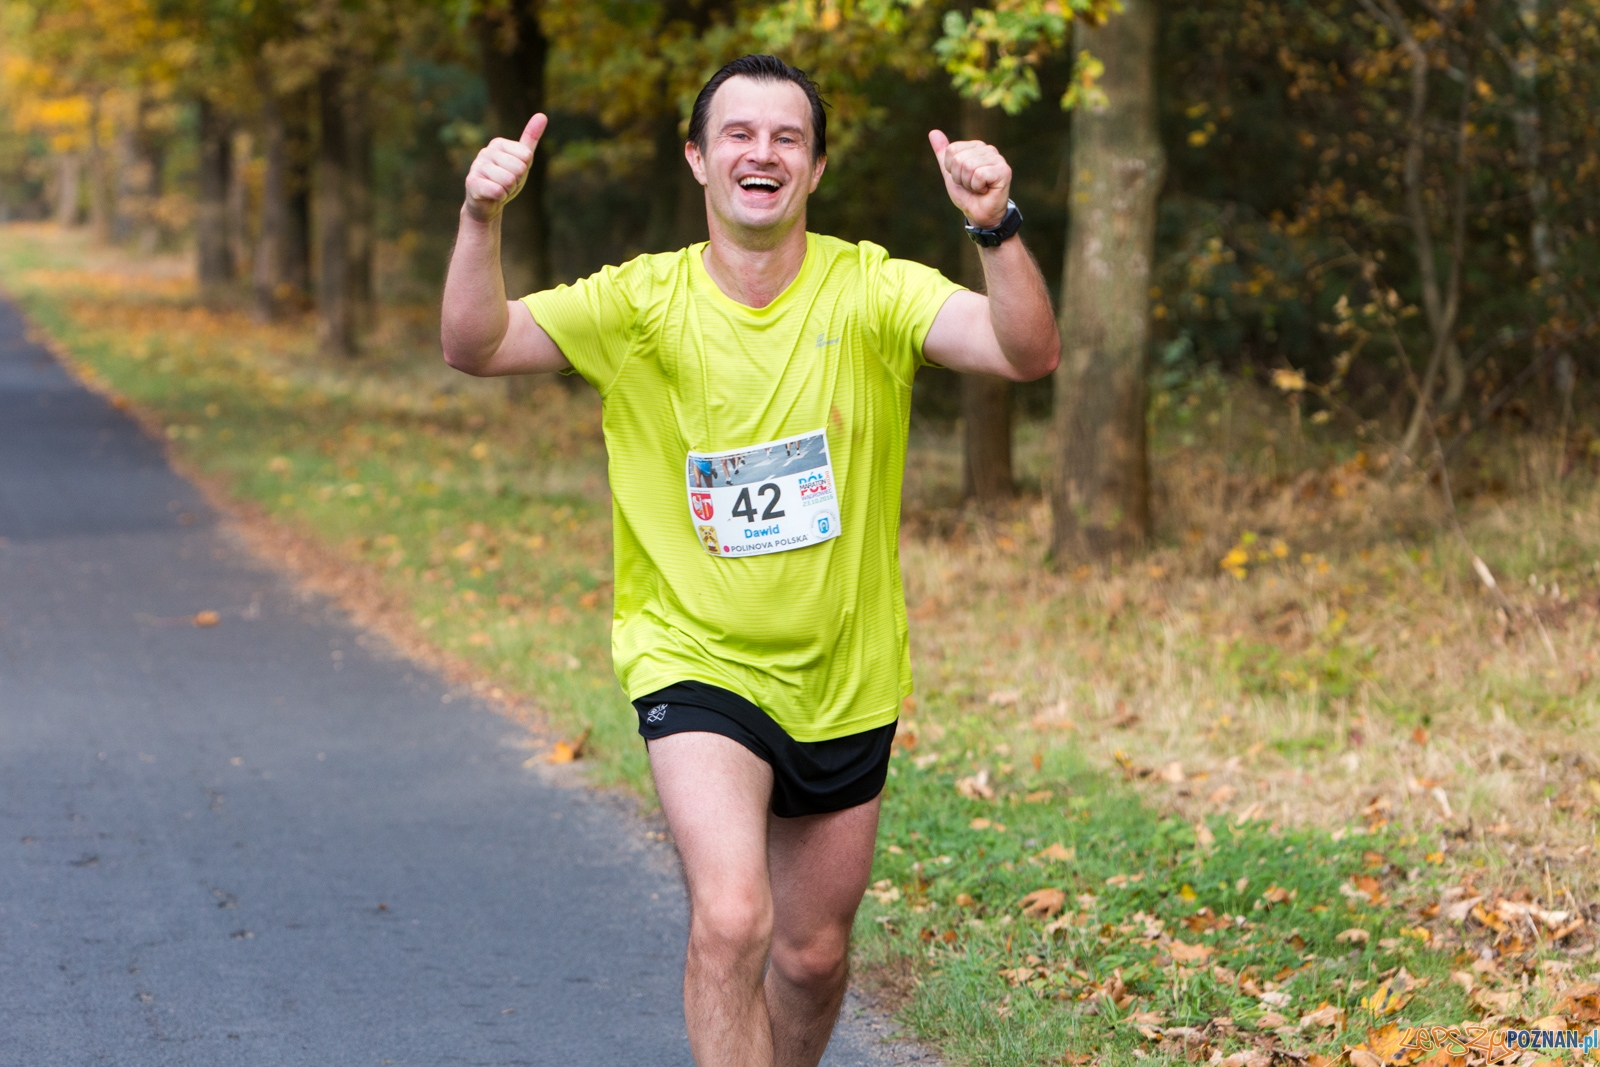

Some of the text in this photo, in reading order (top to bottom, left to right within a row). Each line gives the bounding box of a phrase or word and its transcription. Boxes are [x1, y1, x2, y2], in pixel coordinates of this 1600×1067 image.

[799, 478, 827, 490] MARATON
[731, 483, 786, 523] 42
[744, 524, 780, 539] Dawid
[731, 541, 773, 553] POLINOVA
[775, 535, 808, 547] POLSKA
